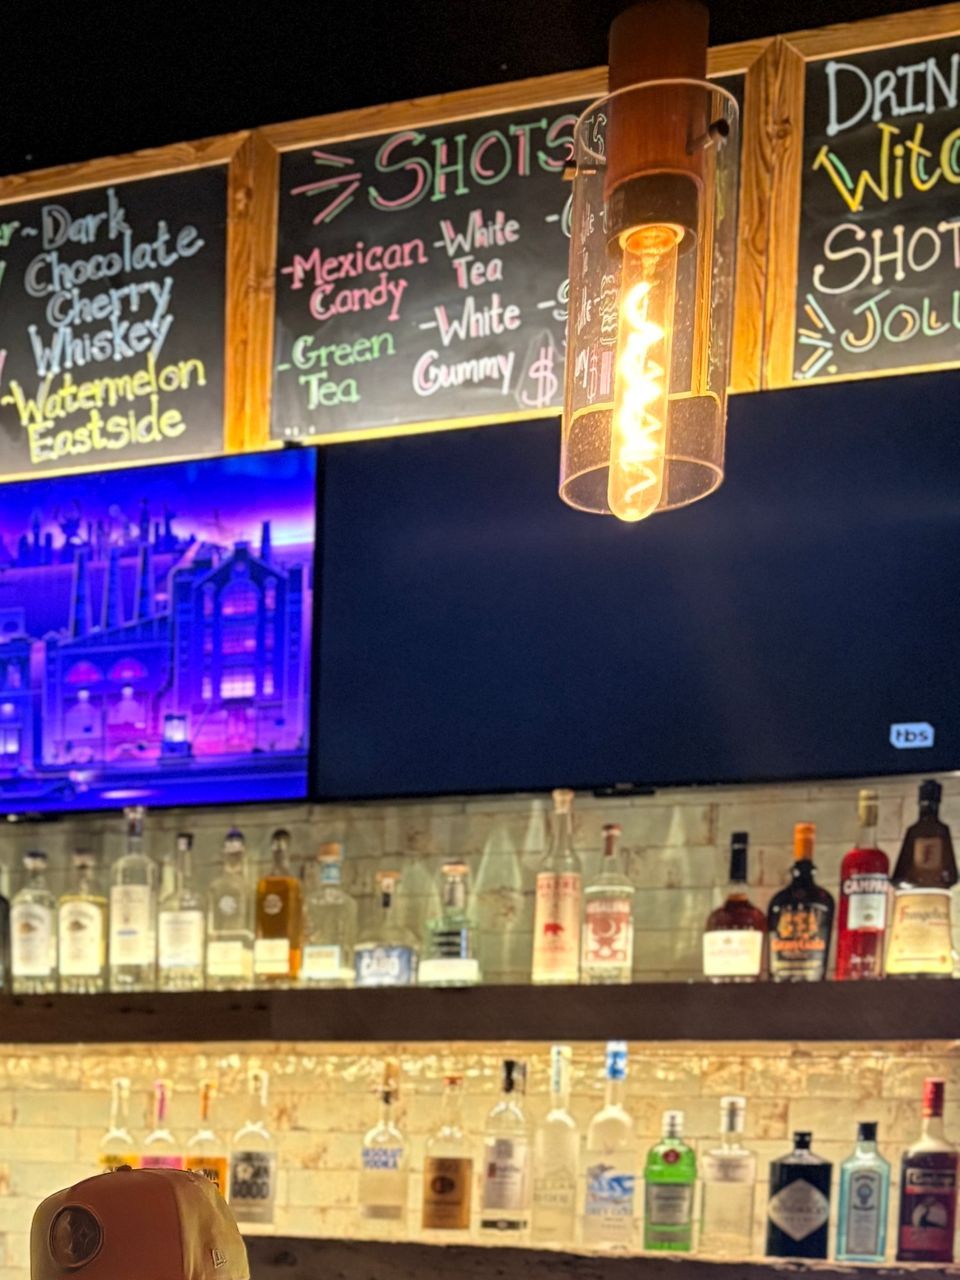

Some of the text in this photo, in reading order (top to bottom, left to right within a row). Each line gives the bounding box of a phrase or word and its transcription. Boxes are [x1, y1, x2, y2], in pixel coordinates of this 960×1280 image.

[368, 114, 578, 211] SHOTS
[24, 220, 204, 297] Chocolate
[452, 253, 503, 289] Tea
[46, 277, 174, 328] Cherry
[309, 272, 408, 322] Candy
[28, 314, 174, 376] Whiskey
[299, 370, 361, 410] Tea
[412, 348, 515, 397] Gummy
[28, 395, 186, 464] Eastside
[895, 727, 929, 743] tbs
